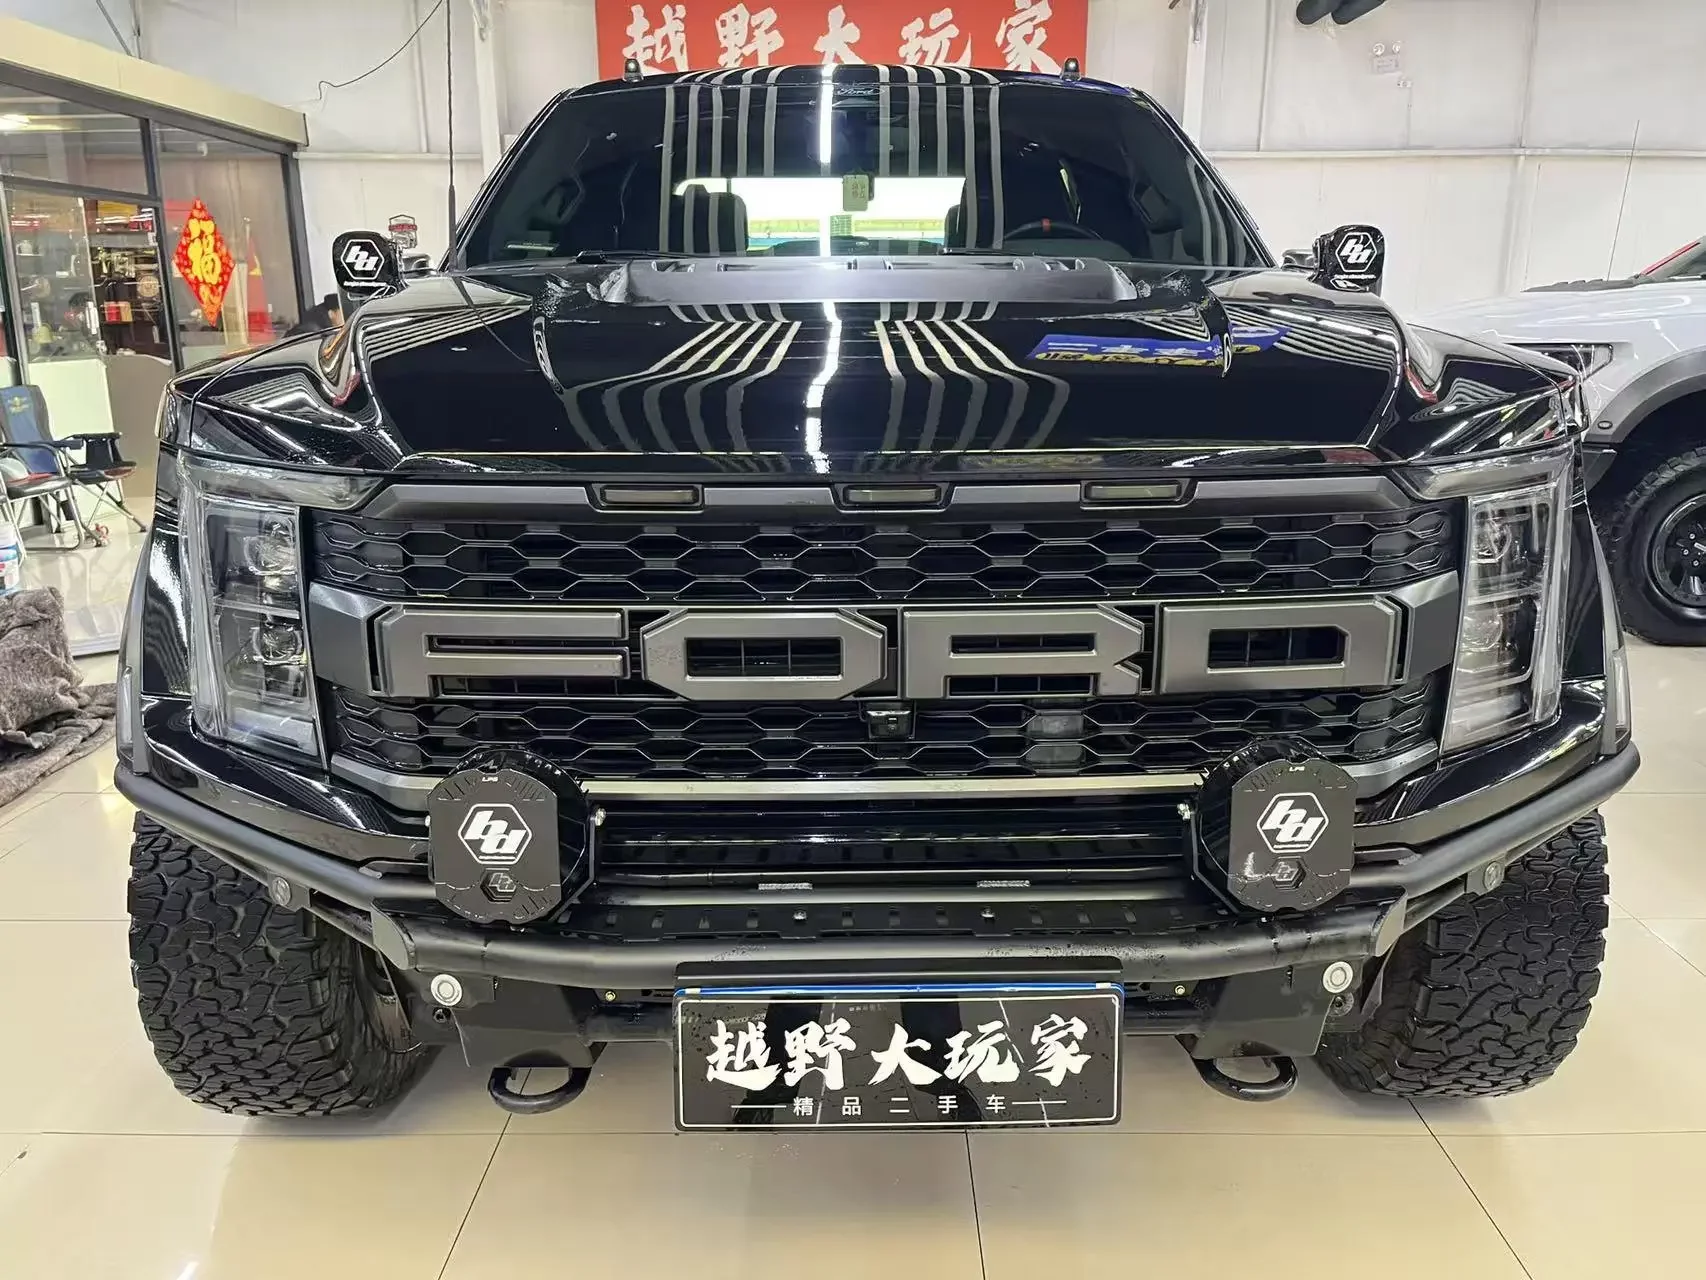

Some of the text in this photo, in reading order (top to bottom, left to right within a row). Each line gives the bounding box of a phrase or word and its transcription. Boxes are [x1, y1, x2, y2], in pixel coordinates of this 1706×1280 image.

[621, 0, 1061, 75] 越野大玩家
[374, 595, 1404, 701] FORD
[705, 1013, 1093, 1092] 越野大玩家
[792, 1094, 1007, 1117] 精品二手车
